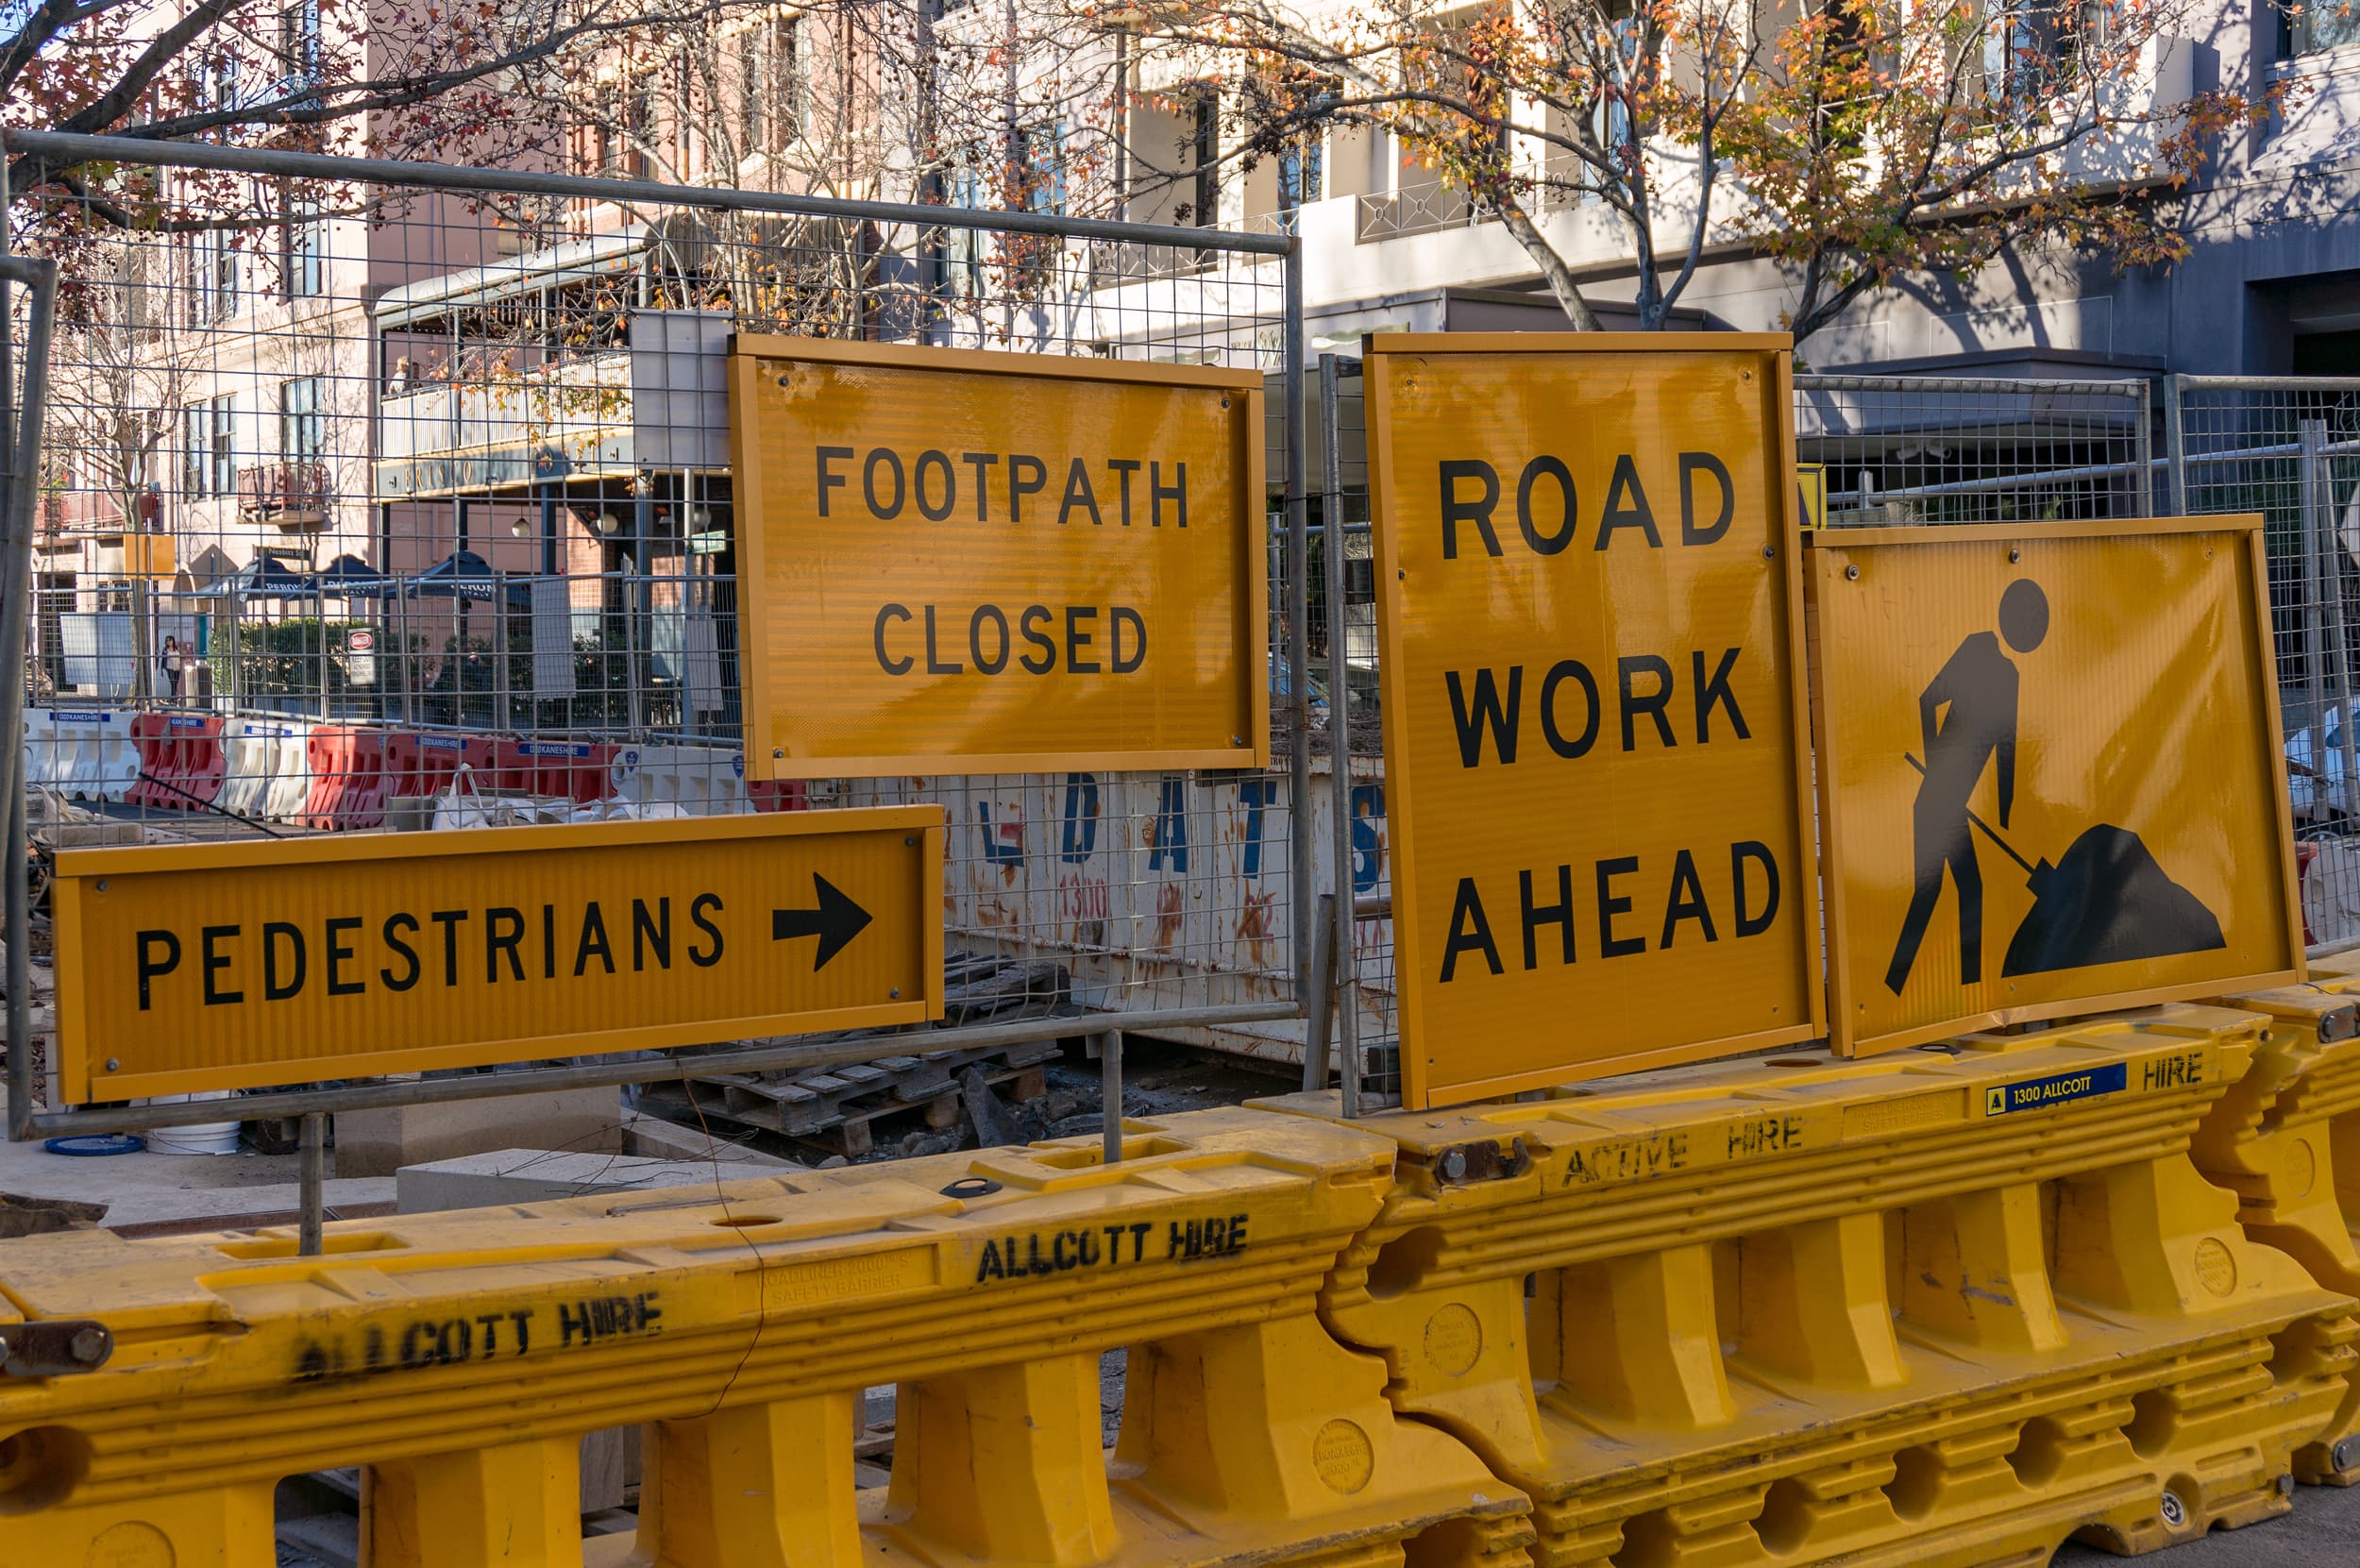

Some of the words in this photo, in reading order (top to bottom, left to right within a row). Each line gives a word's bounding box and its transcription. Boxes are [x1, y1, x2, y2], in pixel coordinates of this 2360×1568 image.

[817, 447, 1187, 528] FOOTPATH
[1440, 452, 1734, 560] ROAD
[875, 605, 1146, 675] CLOSED
[1445, 648, 1751, 768] WORK
[1440, 841, 1780, 983] AHEAD
[136, 893, 724, 1011] PEDESTRIANS
[2014, 1086, 2040, 1104] 1300
[2043, 1076, 2091, 1099] ALLCOTT
[2143, 1052, 2203, 1091] HIRE
[1728, 1117, 1803, 1159] HIRE
[977, 1223, 1153, 1282] ALLCOTT
[1169, 1214, 1249, 1258] HIRE
[559, 1290, 662, 1346] HIRE
